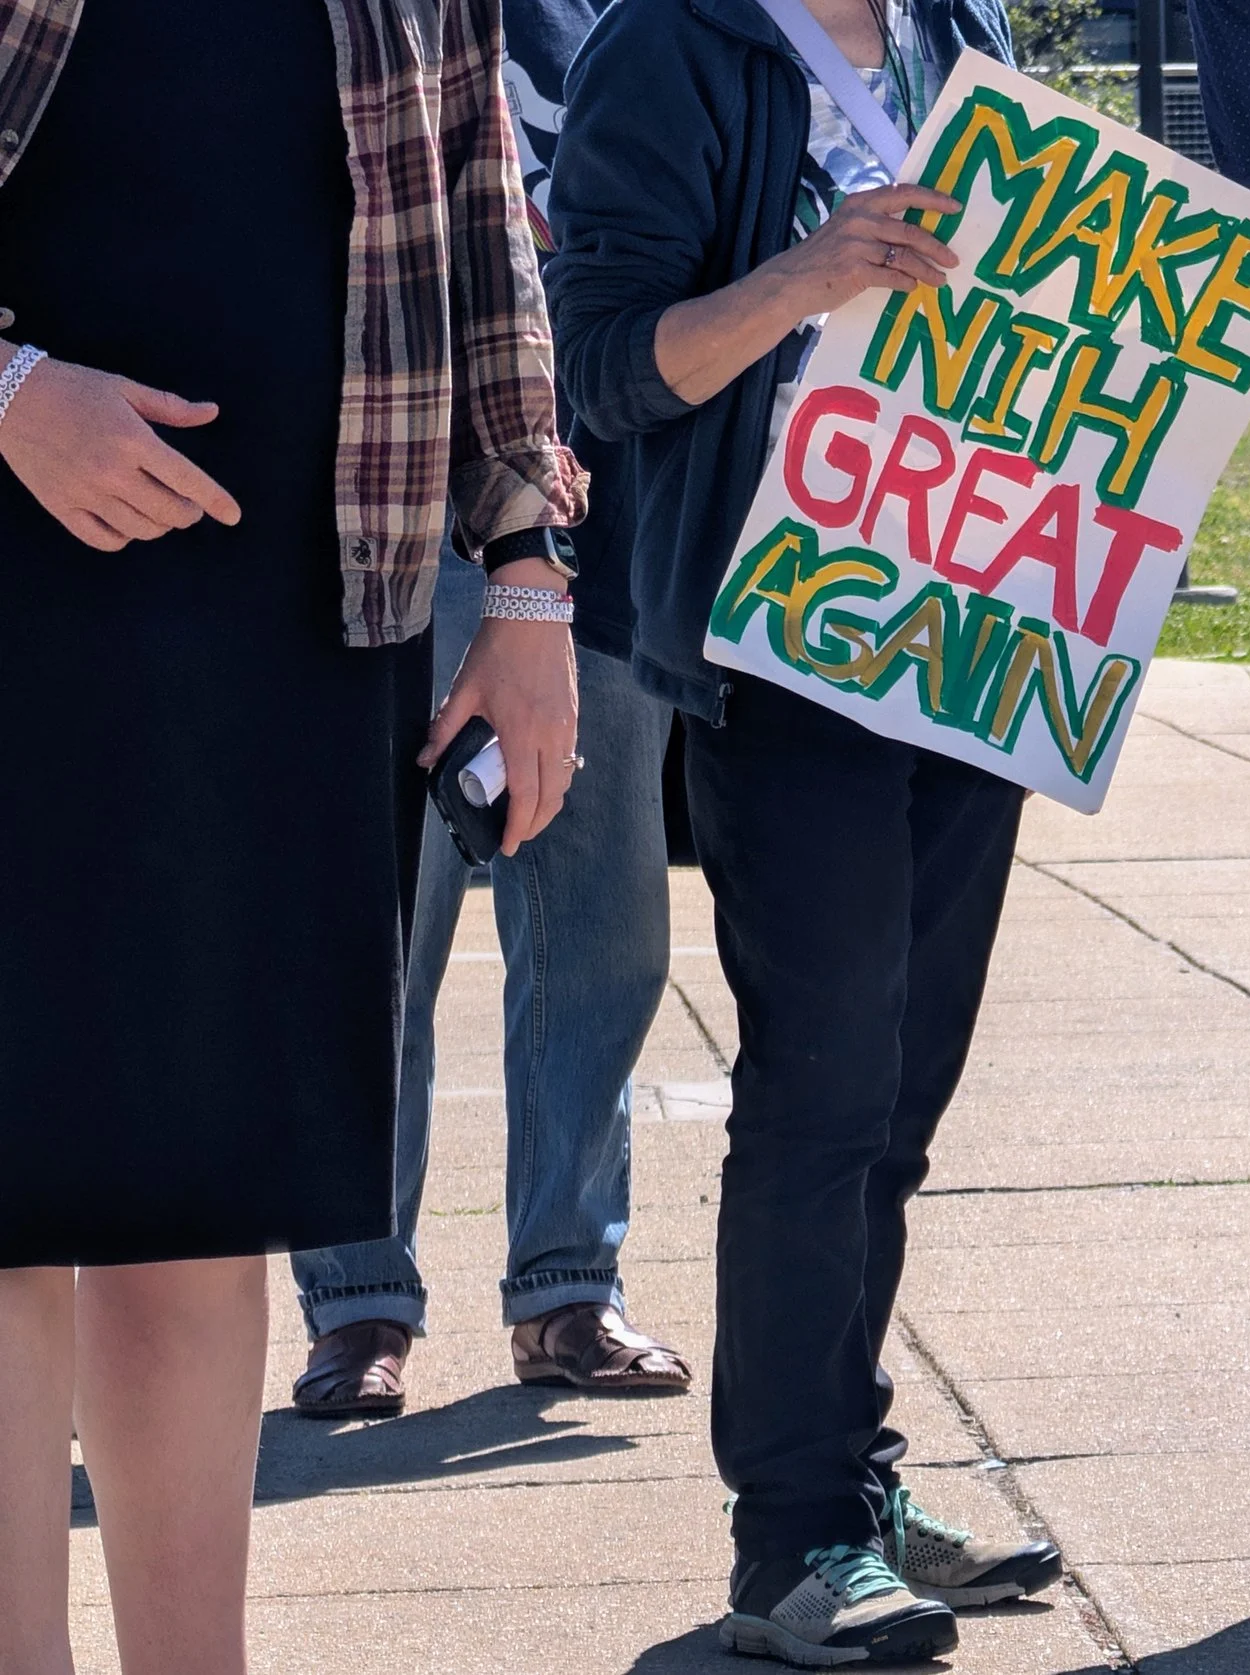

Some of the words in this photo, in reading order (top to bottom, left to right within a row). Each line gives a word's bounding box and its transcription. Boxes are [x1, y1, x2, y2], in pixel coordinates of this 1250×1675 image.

[784, 385, 1184, 648] GREAT
[860, 283, 1188, 509] NIH
[710, 517, 1138, 784] AGAIN
